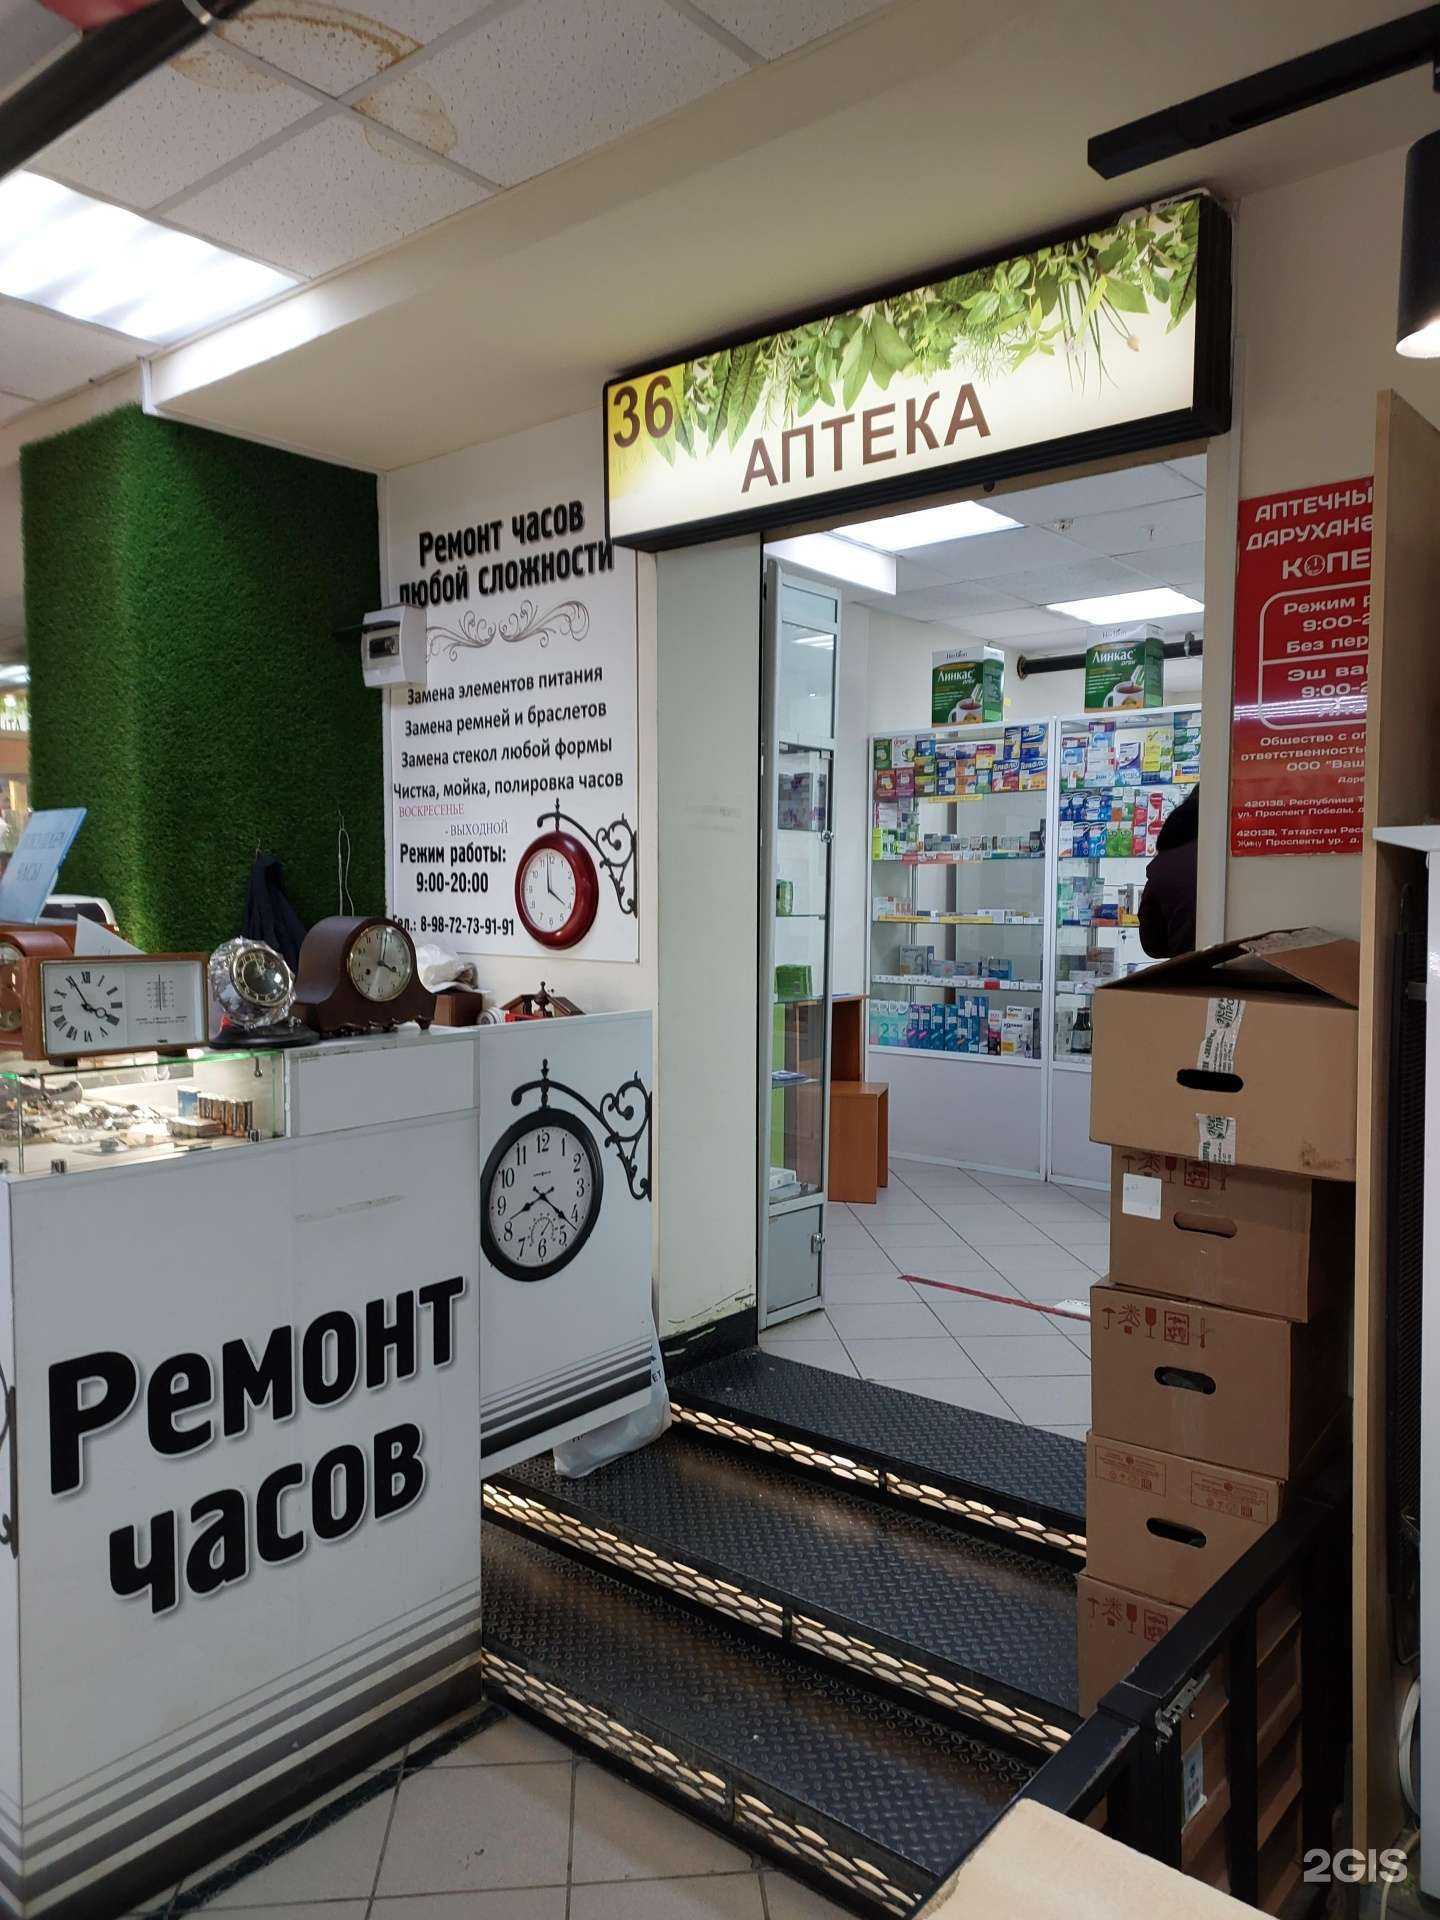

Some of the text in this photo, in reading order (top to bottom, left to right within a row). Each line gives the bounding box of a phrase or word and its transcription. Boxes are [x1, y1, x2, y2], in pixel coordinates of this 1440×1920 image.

[612, 375, 674, 448] 36
[741, 382, 991, 494] АПТЕКА
[419, 500, 583, 566] Ремонт часов
[399, 540, 614, 608] любой сложности
[1284, 597, 1355, 615] Режим
[1286, 636, 1368, 653] Без пер
[1093, 650, 1133, 663] Линкас
[938, 668, 974, 682] Линкас
[1287, 665, 1368, 681] Эш ва
[407, 667, 603, 705] Замена элементов питания
[405, 701, 607, 736] Замена ремней и браслетов
[1260, 734, 1333, 747] Общество
[401, 737, 612, 768] Замена стекол любой формы
[1241, 745, 1367, 761] ответственность
[1286, 761, 1320, 771] ООО
[393, 772, 624, 800] Чистка, мойка, полировка часов
[399, 804, 464, 817] ВОСКРЕСЕНЬЕ
[1255, 809, 1305, 818] Проспект
[400, 841, 506, 867] Режим работы:
[416, 872, 489, 893] 9:00-20:00
[420, 915, 515, 936] 8-98-72-73-91-91
[537, 1132, 550, 1153] 12
[561, 1137, 566, 1157] 1
[516, 1143, 526, 1165] 11
[573, 1153, 582, 1173] 2
[501, 1168, 515, 1189] 10
[576, 1178, 585, 1198] 3
[497, 1196, 507, 1216] 9
[571, 1204, 578, 1223] 4
[504, 1221, 513, 1242] 8
[559, 1225, 567, 1245] 5
[518, 1236, 526, 1257] 7
[538, 1238, 547, 1258] 6
[48, 1276, 465, 1496] Ремонт
[109, 1422, 426, 1616] часов
